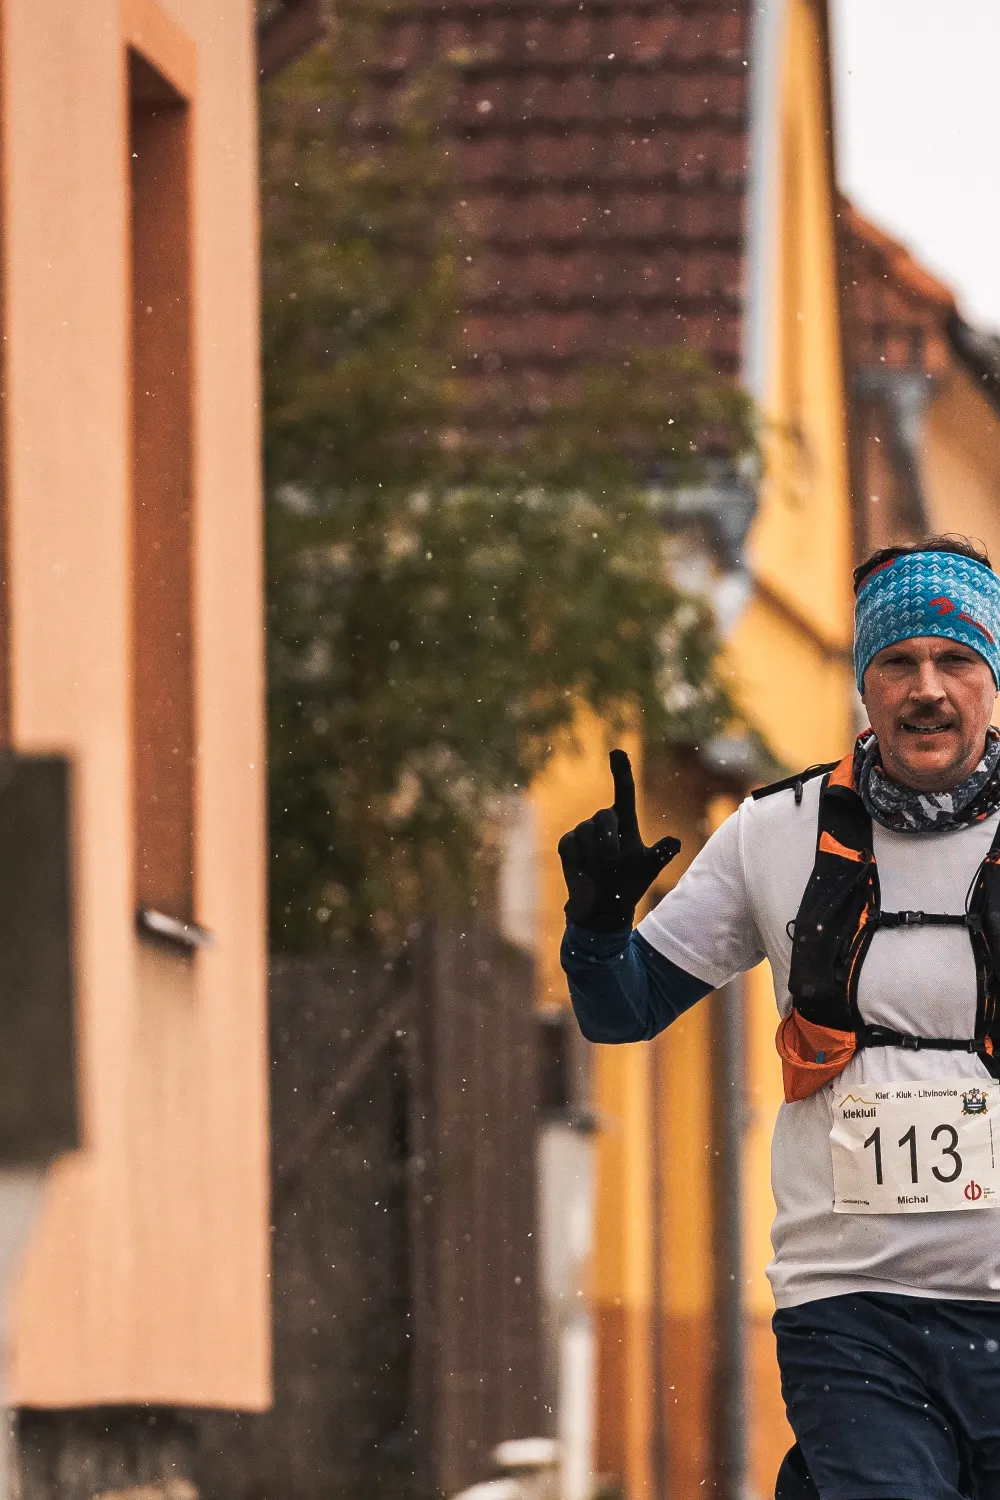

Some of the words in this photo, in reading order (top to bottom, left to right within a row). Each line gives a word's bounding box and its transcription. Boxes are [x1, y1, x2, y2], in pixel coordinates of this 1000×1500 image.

[896, 1090, 912, 1099] Kluk
[843, 1107, 876, 1119] klekluli
[863, 1123, 963, 1185] 113
[897, 1195, 929, 1204] Michal
